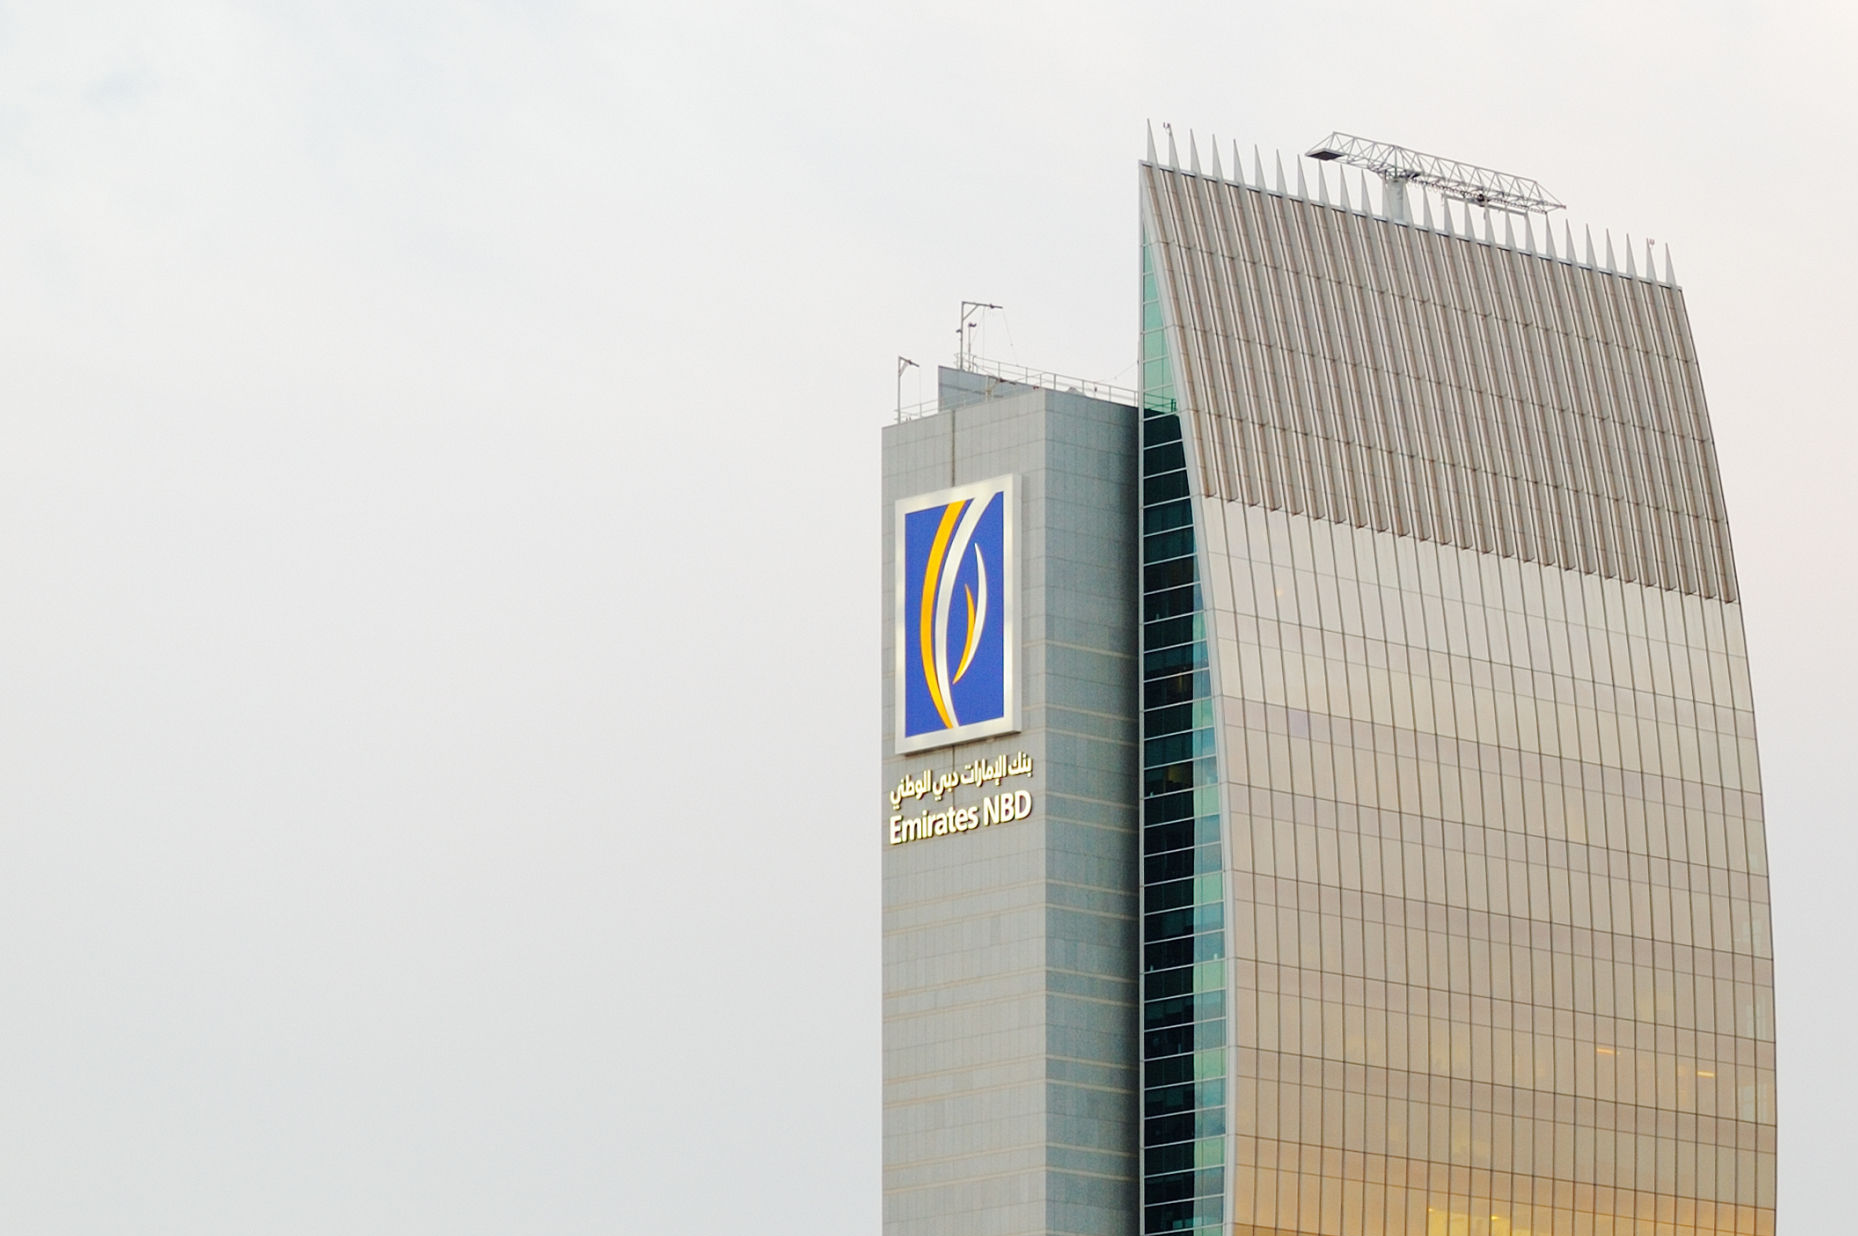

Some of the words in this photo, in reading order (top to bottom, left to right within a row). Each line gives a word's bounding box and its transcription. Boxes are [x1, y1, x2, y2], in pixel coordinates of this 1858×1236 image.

[1008, 752, 1032, 777] بنك
[890, 769, 932, 810] الوطني
[933, 771, 959, 800] دبي
[890, 806, 979, 844] Emirates
[983, 790, 1032, 826] NBD
